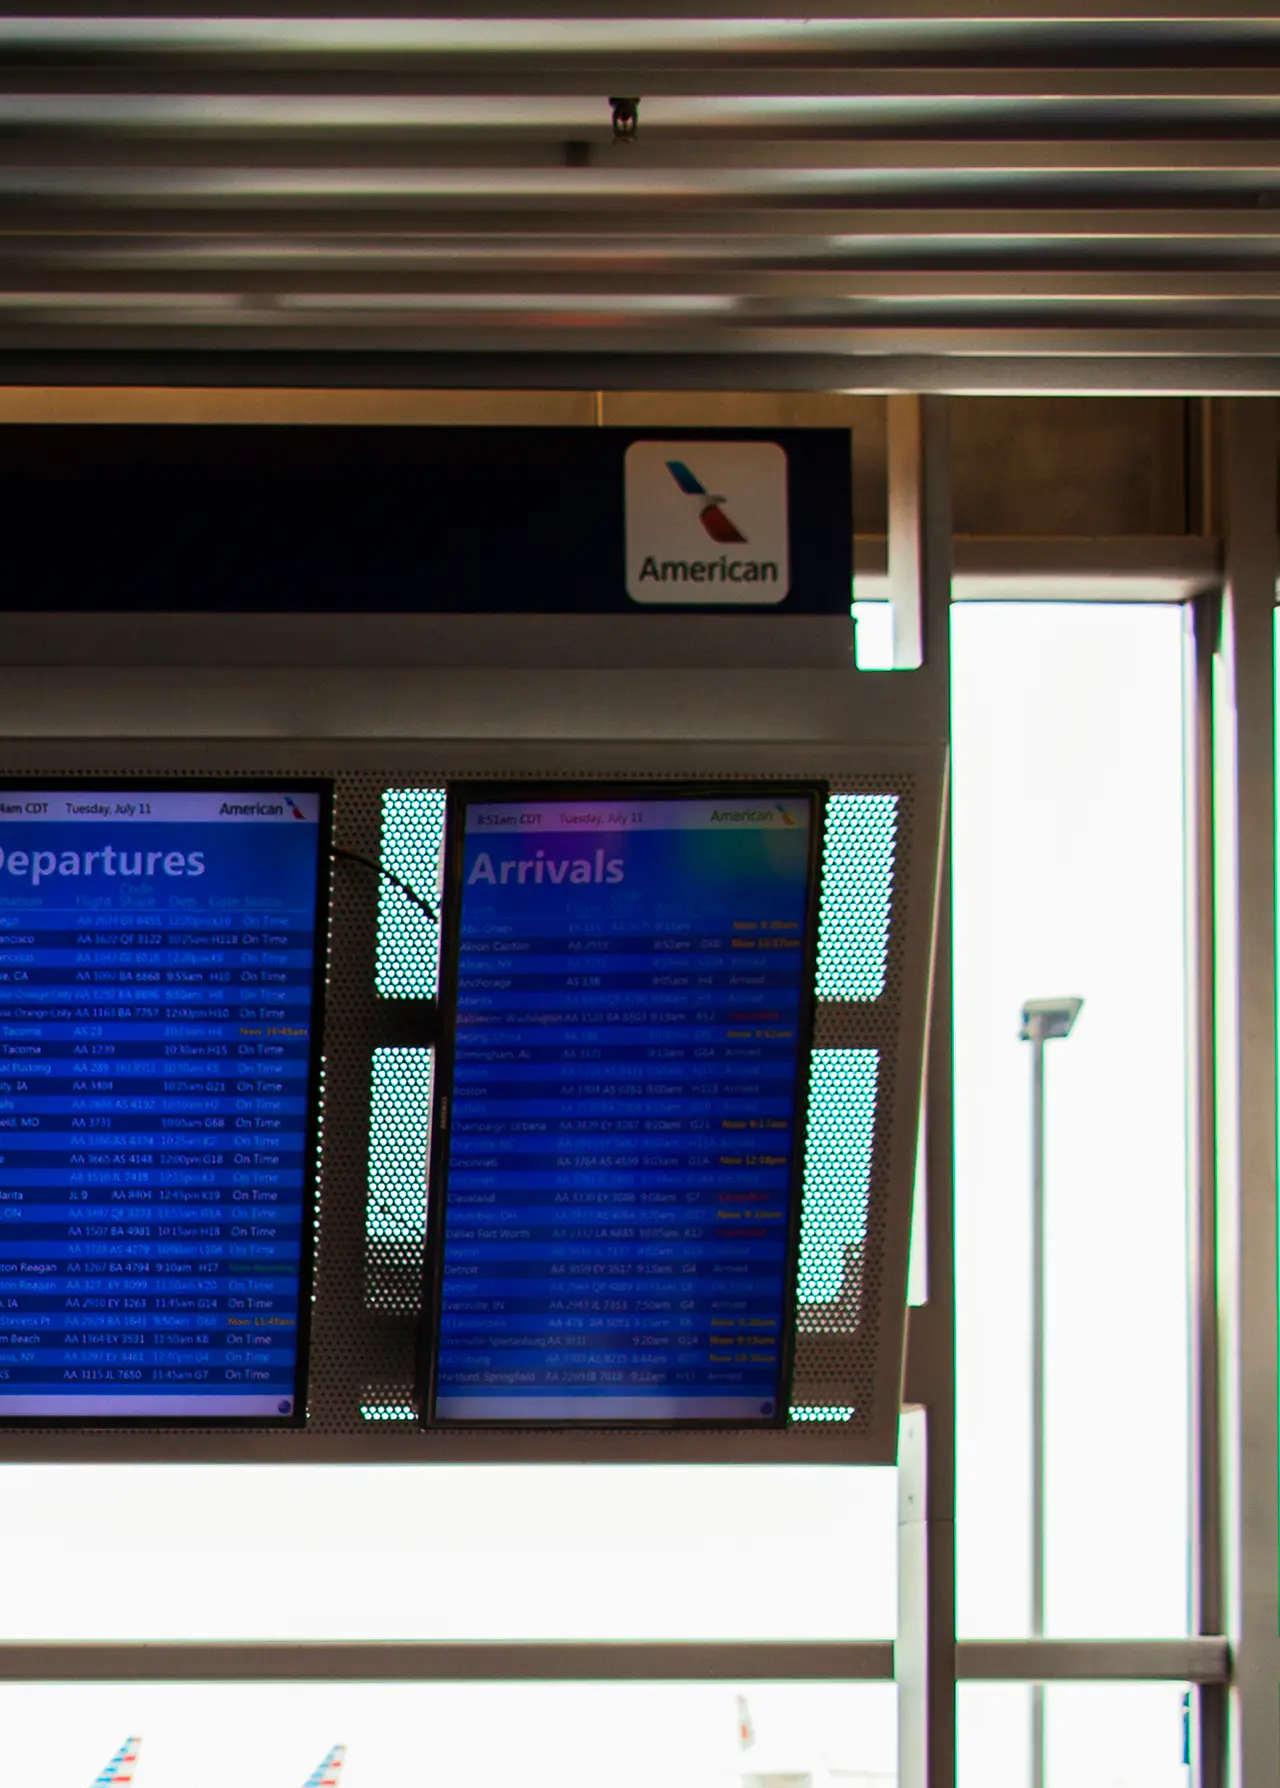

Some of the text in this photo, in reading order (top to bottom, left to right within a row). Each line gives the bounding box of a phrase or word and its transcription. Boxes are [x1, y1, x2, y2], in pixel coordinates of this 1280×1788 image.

[639, 555, 778, 583] American
[25, 803, 48, 814] CDT
[66, 803, 112, 816] Tuesday,
[115, 803, 135, 816] July
[139, 803, 150, 814] 11
[220, 803, 283, 815] American
[519, 814, 542, 824] CDT
[559, 814, 604, 826] Tuesday,
[608, 814, 628, 826] July
[632, 814, 643, 824] 11
[711, 809, 773, 822] American
[468, 849, 624, 885] Arrivals
[500, 1228, 530, 1238] Worth
[16, 1334, 40, 1344] Beach
[227, 1334, 242, 1344] On
[246, 1334, 271, 1344] Time
[118, 1370, 142, 1379] 7650
[225, 1370, 241, 1379] On
[245, 1370, 270, 1379] Time
